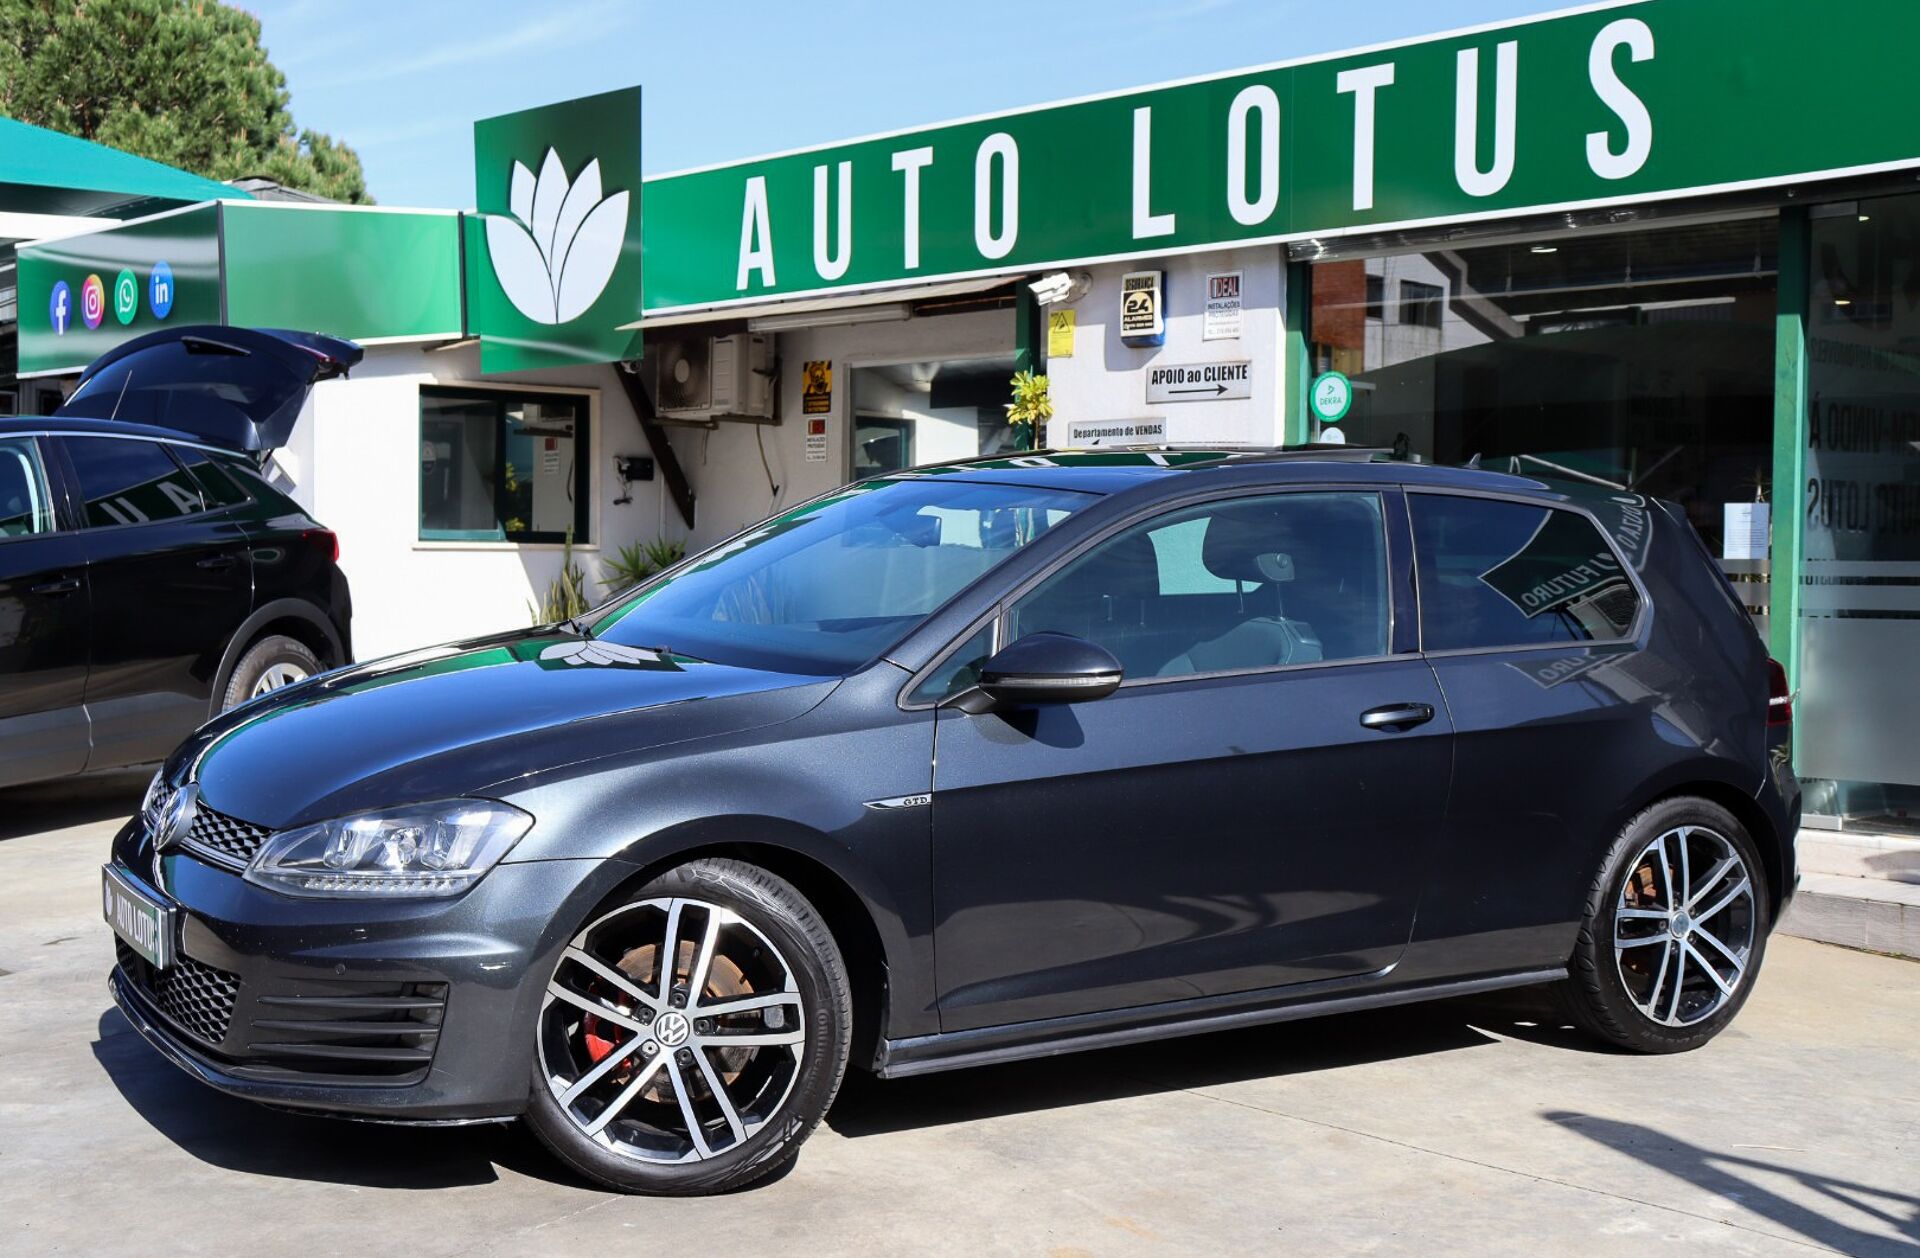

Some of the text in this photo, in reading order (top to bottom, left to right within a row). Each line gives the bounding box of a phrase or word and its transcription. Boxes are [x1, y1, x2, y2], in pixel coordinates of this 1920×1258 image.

[736, 18, 1655, 291] AUTO LOTUS
[1127, 298, 1150, 313] 24
[1151, 364, 1248, 385] APOIO ao CLIENTE
[1319, 396, 1342, 406] DEKRA
[1073, 424, 1163, 439] Departamento de VENDAS
[903, 796, 928, 806] GTD
